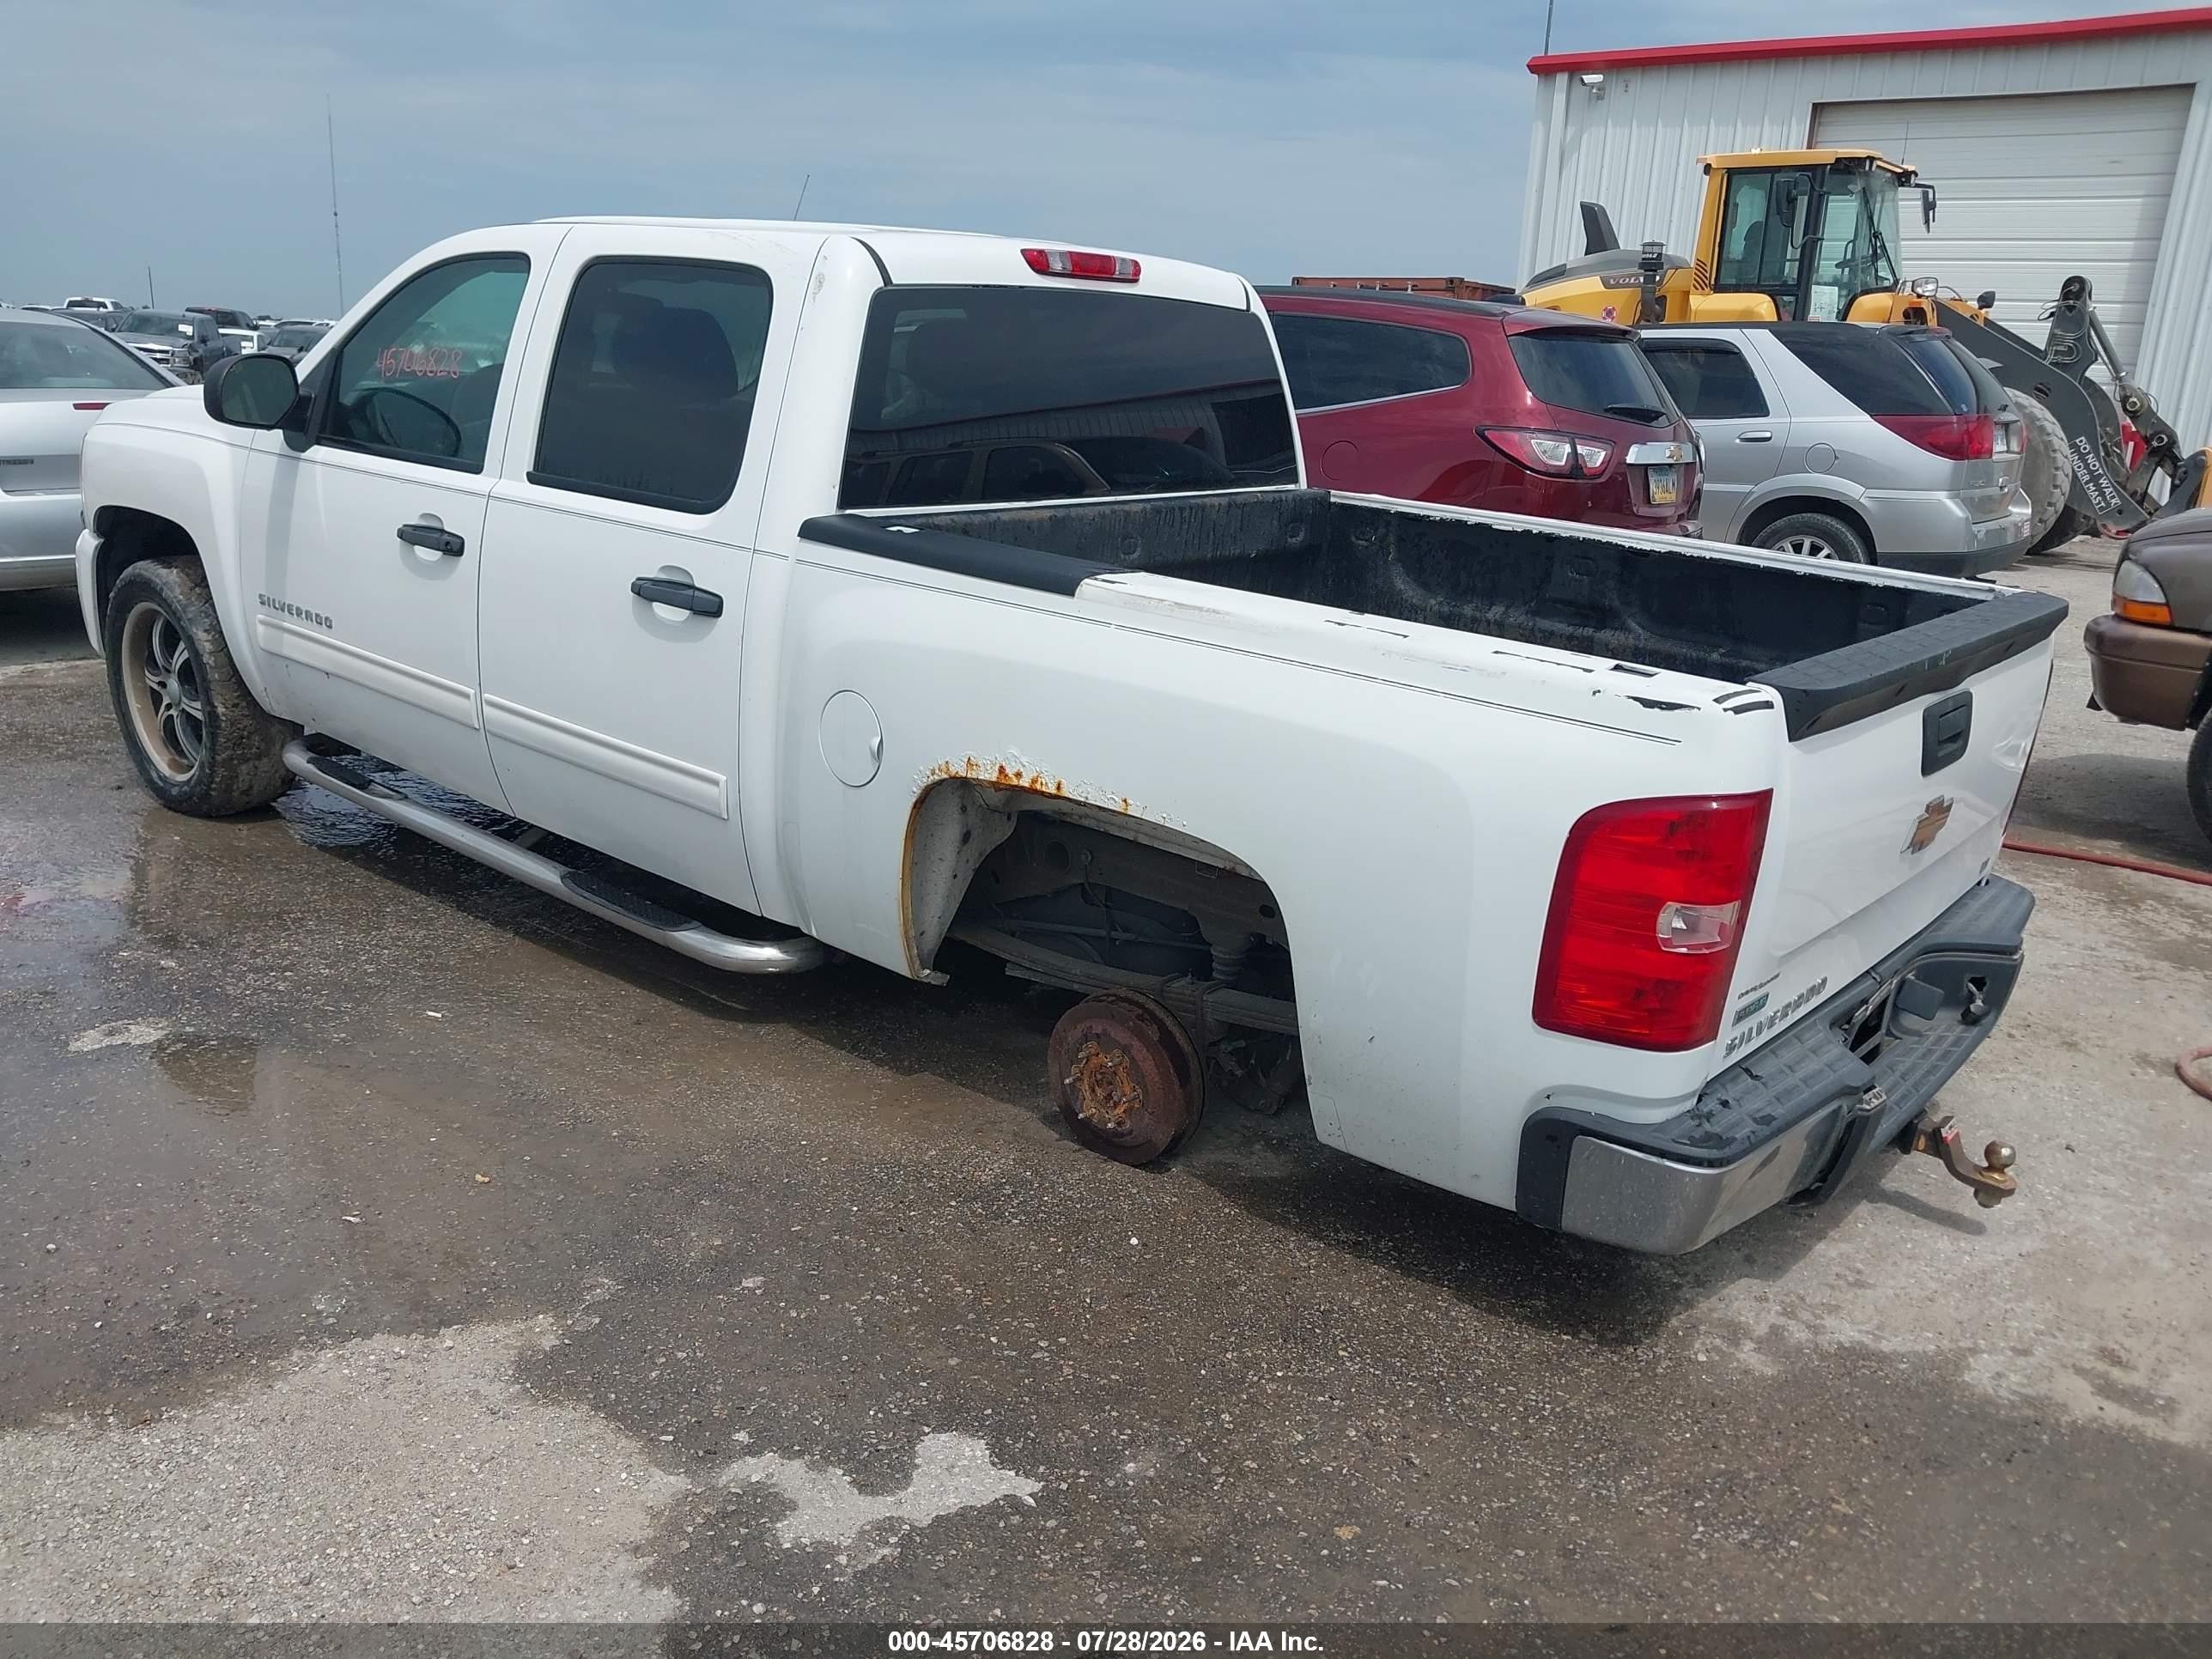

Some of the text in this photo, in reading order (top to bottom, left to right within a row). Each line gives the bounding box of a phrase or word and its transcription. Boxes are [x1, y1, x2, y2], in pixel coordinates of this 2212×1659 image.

[376, 347, 462, 382] 45706828
[2075, 436, 2122, 507] DO NOT WALK
[2085, 483, 2106, 507] MAST
[258, 593, 333, 629] SILVERADO
[1723, 975, 1828, 1059] SILVERADO
